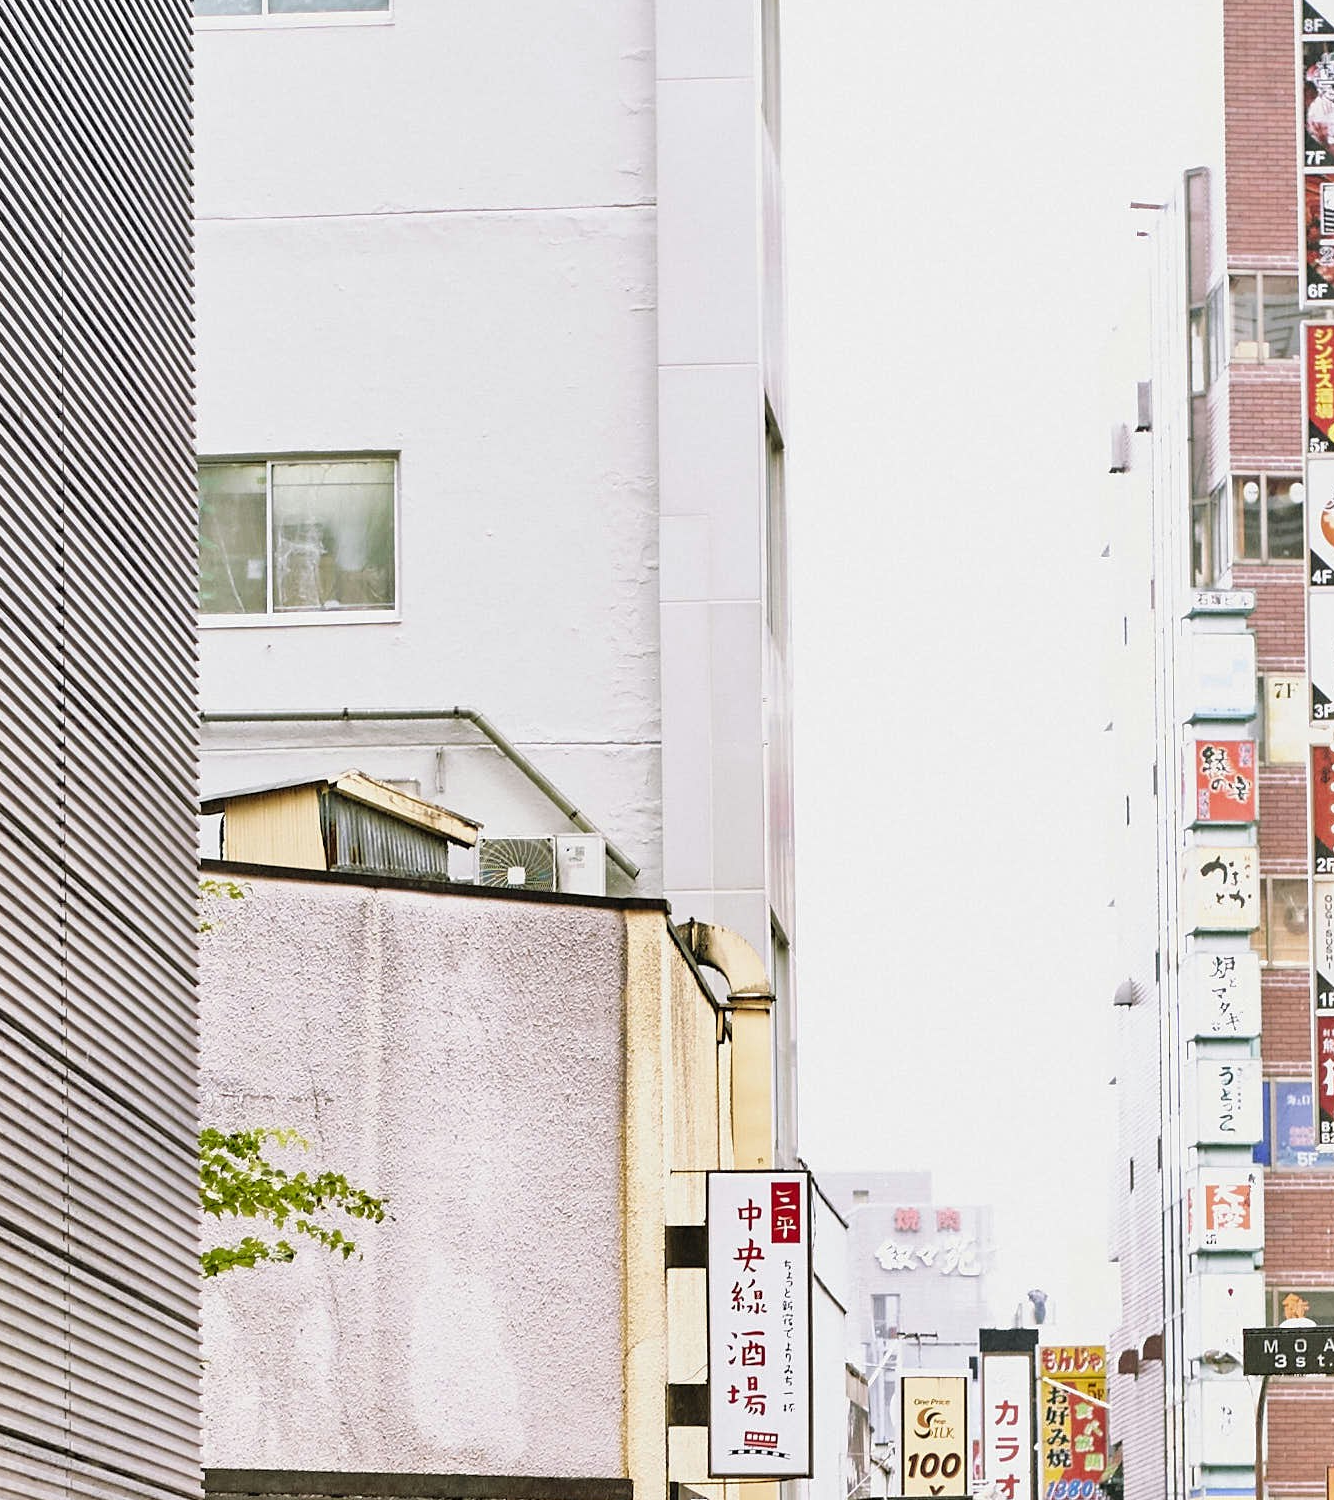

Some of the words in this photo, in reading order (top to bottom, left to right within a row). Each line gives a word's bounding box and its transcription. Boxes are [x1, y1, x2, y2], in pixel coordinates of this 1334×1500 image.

[1304, 18, 1324, 32] 8F
[1306, 150, 1327, 165] 7F
[1307, 284, 1328, 298] 6F
[1309, 438, 1330, 452] 5F
[1311, 569, 1333, 584] 4F
[775, 1190, 797, 1239] 三平
[727, 1198, 768, 1417] 中央線酒場
[1041, 1349, 1104, 1373] もんじゃ
[1274, 1353, 1333, 1368] 3st.
[1046, 1386, 1072, 1468] お好み焼
[908, 1451, 961, 1479] 100
